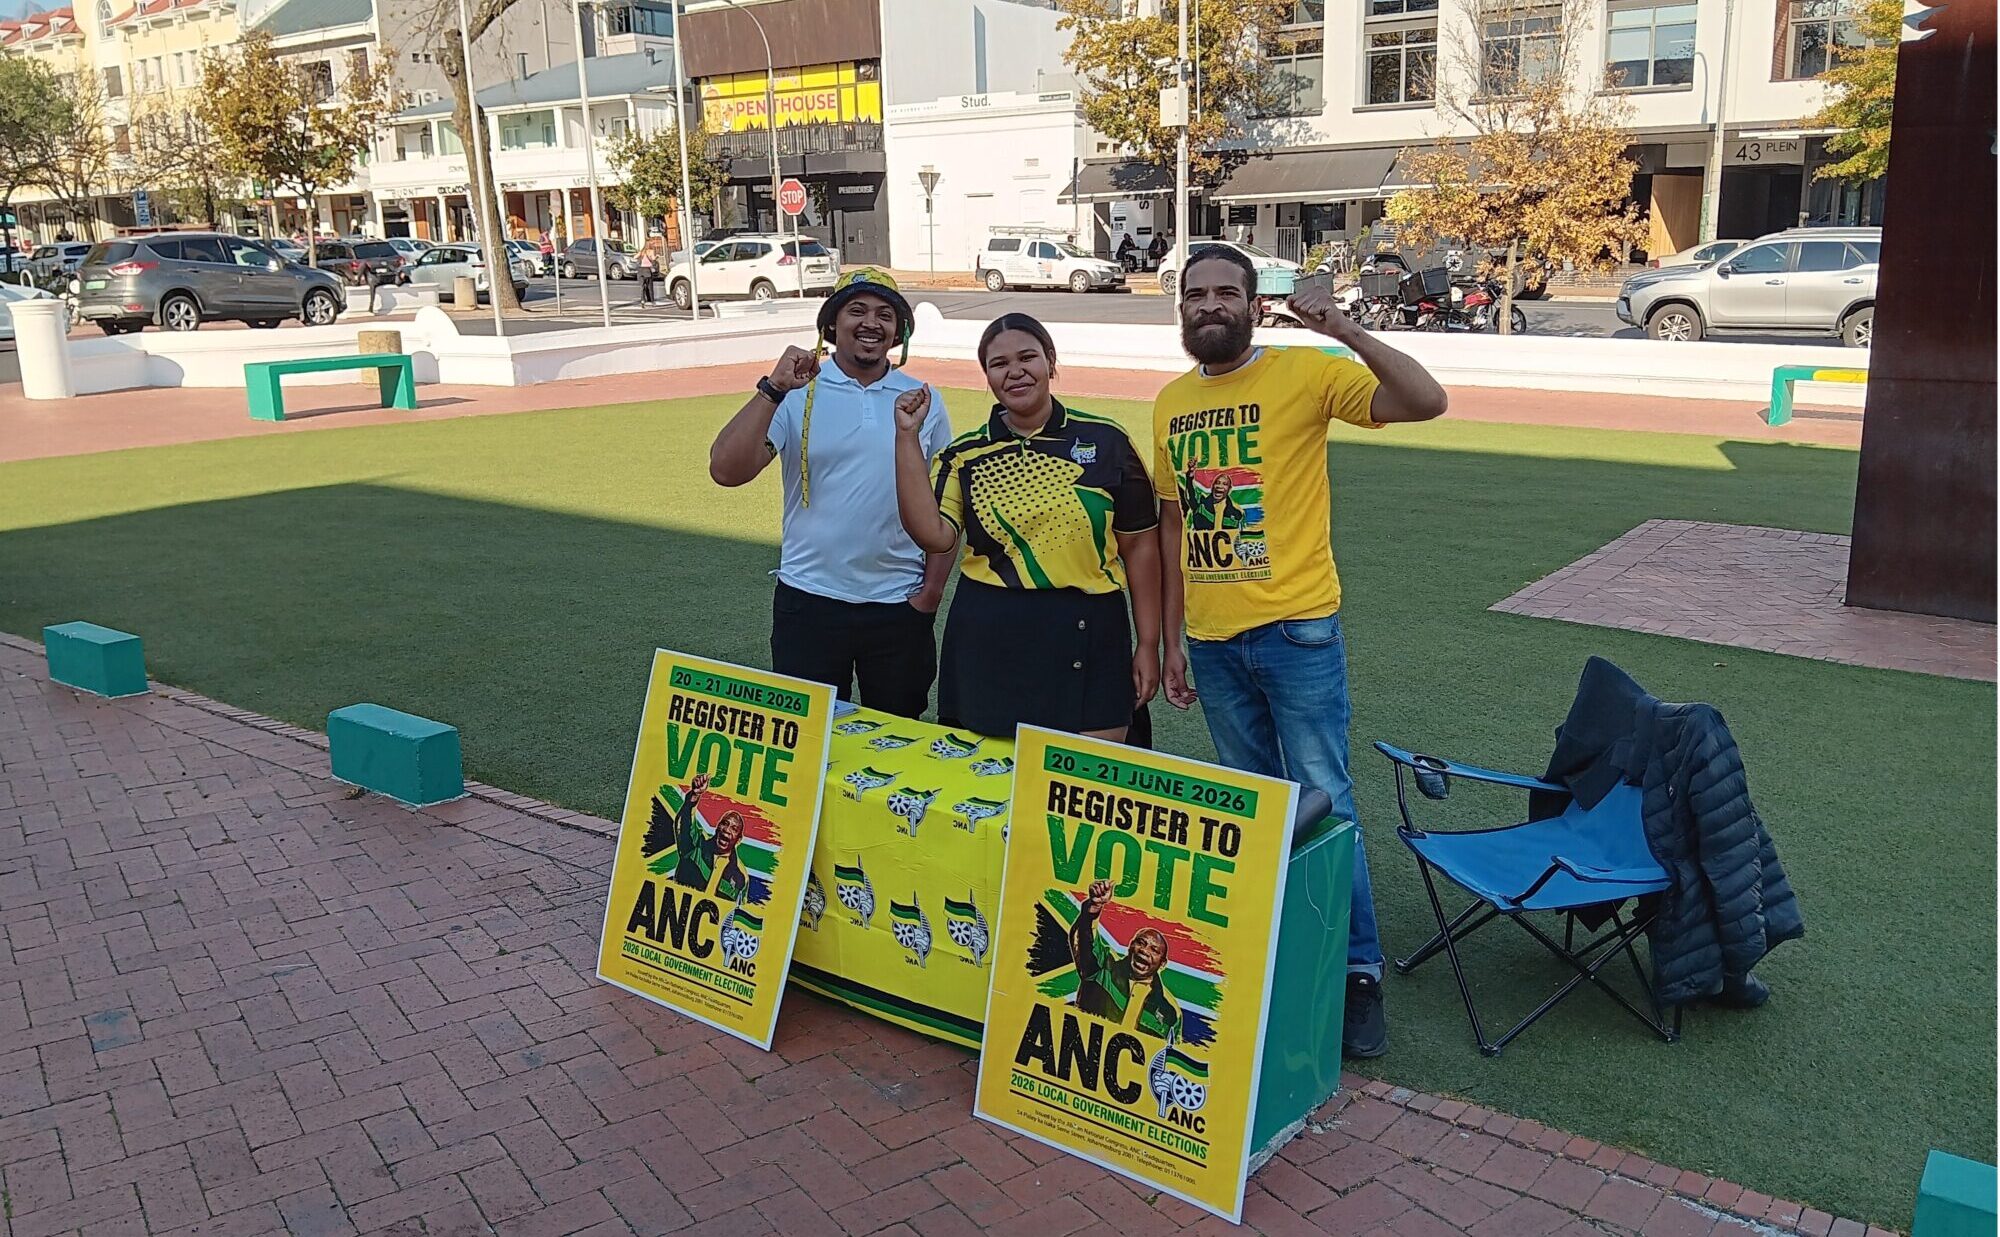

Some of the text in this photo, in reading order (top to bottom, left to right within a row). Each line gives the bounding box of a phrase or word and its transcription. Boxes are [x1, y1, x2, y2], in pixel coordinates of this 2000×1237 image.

[736, 94, 836, 116] PENTHOUSE
[962, 96, 991, 108] Stud.
[1736, 142, 1798, 161] 43 PLEIN
[781, 191, 803, 204] STOP
[1169, 403, 1260, 436] REGISTER TO
[1168, 424, 1262, 471] VOTE
[1187, 531, 1233, 568] ANC
[1249, 556, 1270, 566] ANC
[675, 672, 691, 686] 20
[706, 678, 720, 692] 21
[725, 682, 763, 702] JUNE
[767, 691, 802, 712] 2026
[668, 694, 799, 749] REGISTER TO
[666, 722, 794, 807] VOTE
[1051, 752, 1076, 772] 20
[1096, 763, 1119, 782] 21
[1128, 770, 1184, 798] JUNE
[1190, 784, 1246, 811] 2026
[1048, 780, 1242, 858] REGISTER TO
[1046, 814, 1236, 928] VOTE
[626, 880, 720, 959] ANC
[623, 940, 640, 955] 2026
[640, 946, 662, 964] LOCAL
[664, 957, 713, 982] GOVERNMENT
[714, 974, 754, 999] ELECTIONS
[729, 956, 756, 978] ANC
[1014, 1003, 1146, 1104] ANC
[1010, 1073, 1207, 1160] 2026 LOCAL GOVERNMENT ELECTIONS
[1168, 1106, 1205, 1134] ANC
